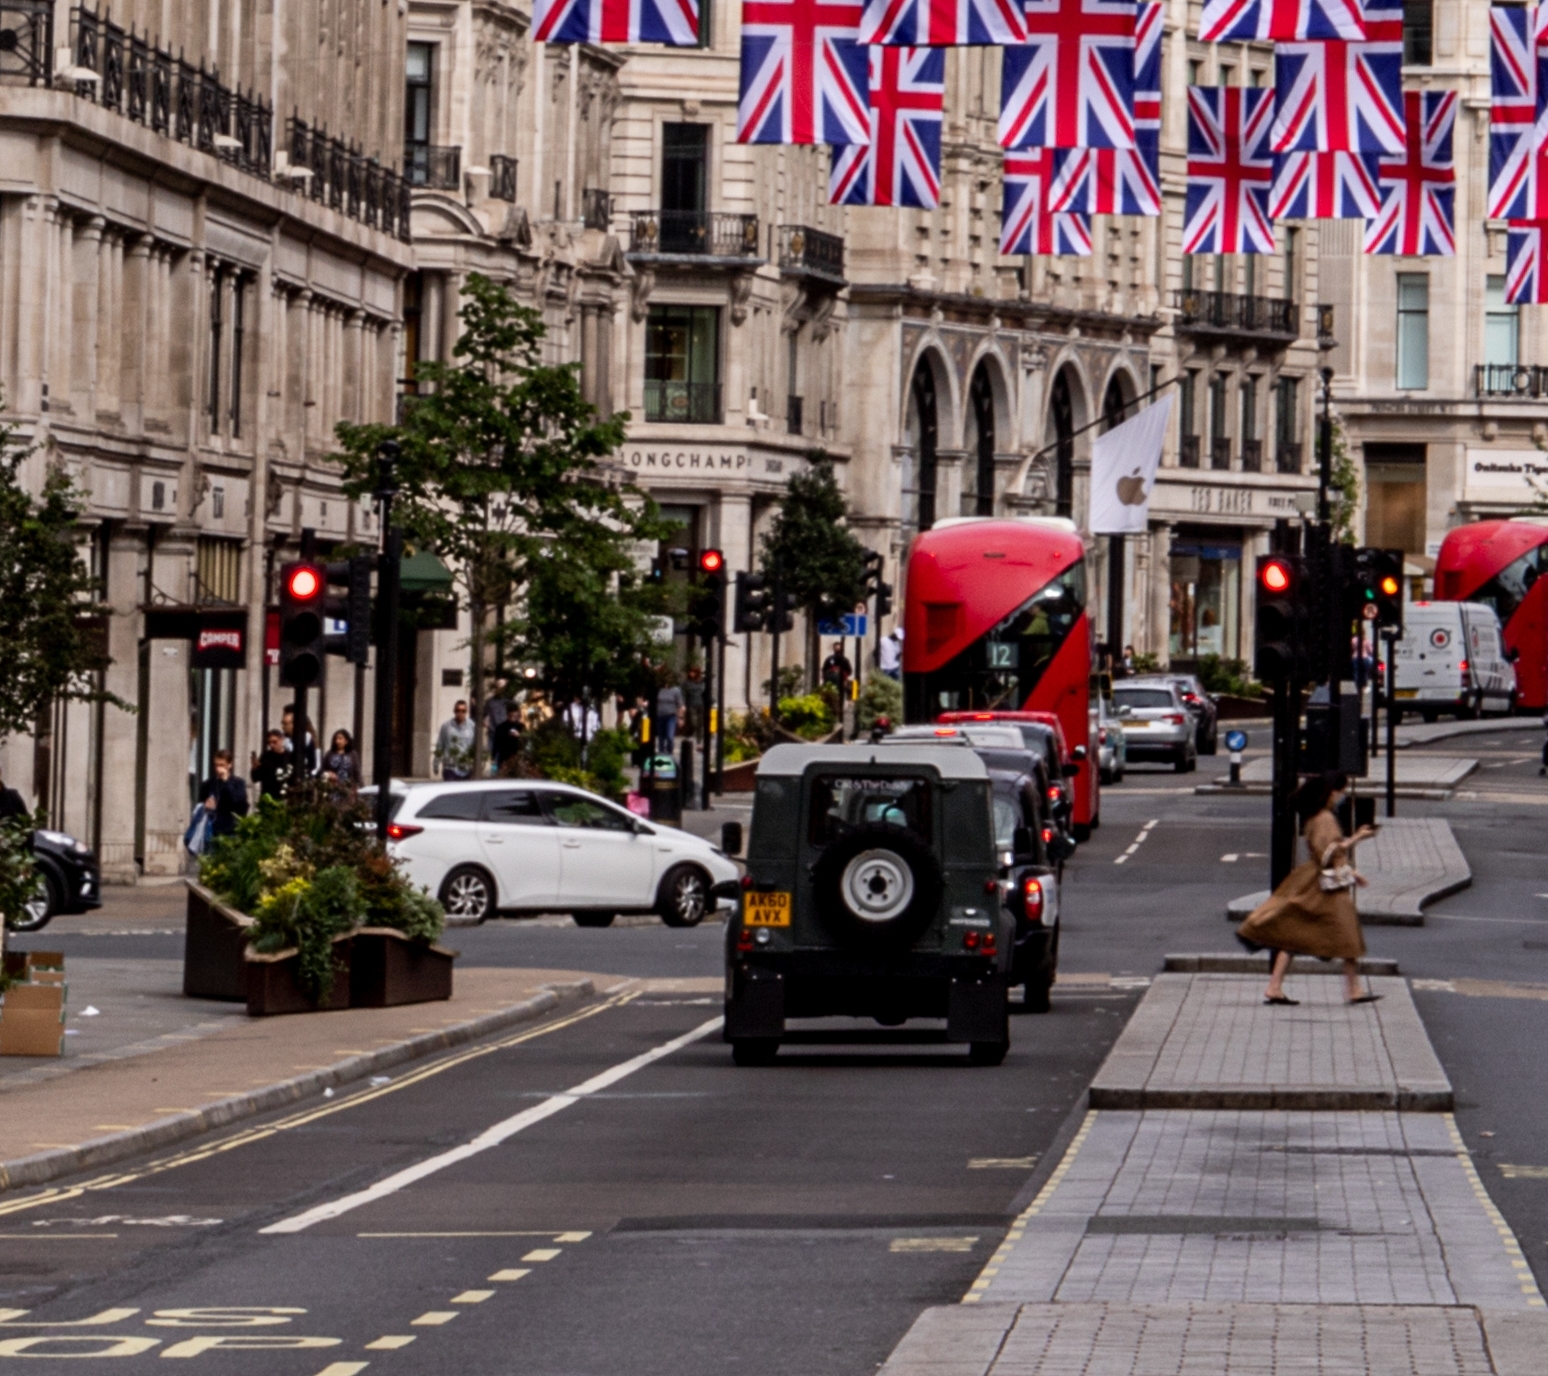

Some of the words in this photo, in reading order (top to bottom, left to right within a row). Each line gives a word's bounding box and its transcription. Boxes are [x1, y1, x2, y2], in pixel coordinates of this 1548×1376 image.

[621, 451, 746, 470] LONGCHAMP
[199, 631, 240, 649] CAMPER
[991, 647, 1011, 666] 12
[749, 894, 787, 908] AK60
[753, 909, 782, 923] AVX
